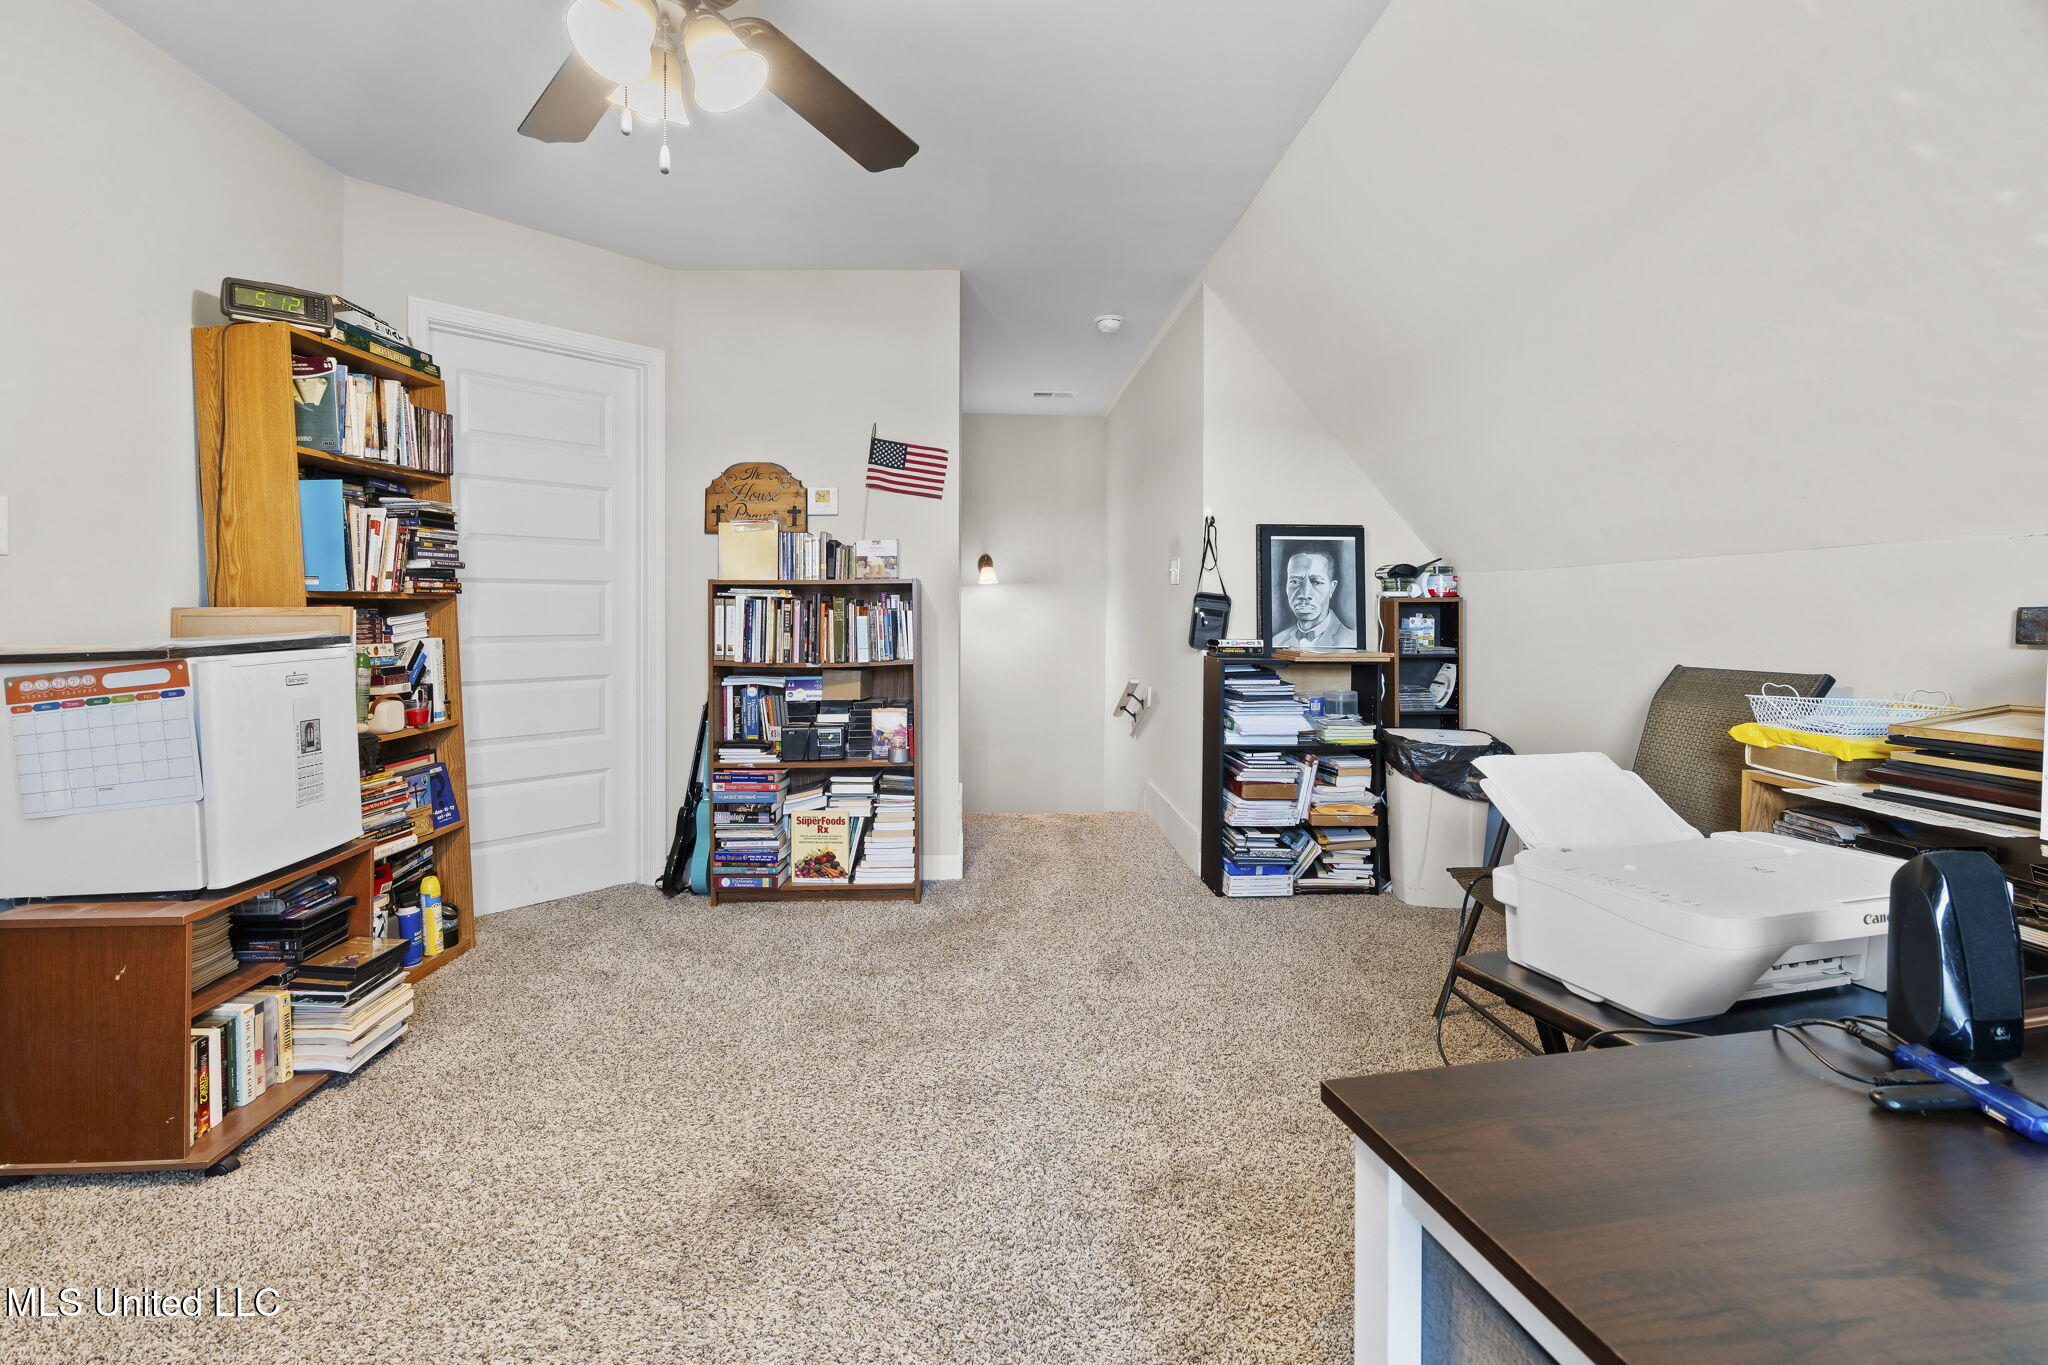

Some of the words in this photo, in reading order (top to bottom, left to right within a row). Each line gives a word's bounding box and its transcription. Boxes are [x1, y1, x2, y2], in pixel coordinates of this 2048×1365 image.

[255, 291, 301, 313] 5:12
[739, 465, 765, 481] The
[796, 816, 846, 827] SuperFoods
[817, 825, 829, 834] Rx
[1863, 913, 1890, 925] Can
[284, 1012, 292, 1051] RAWHIDE
